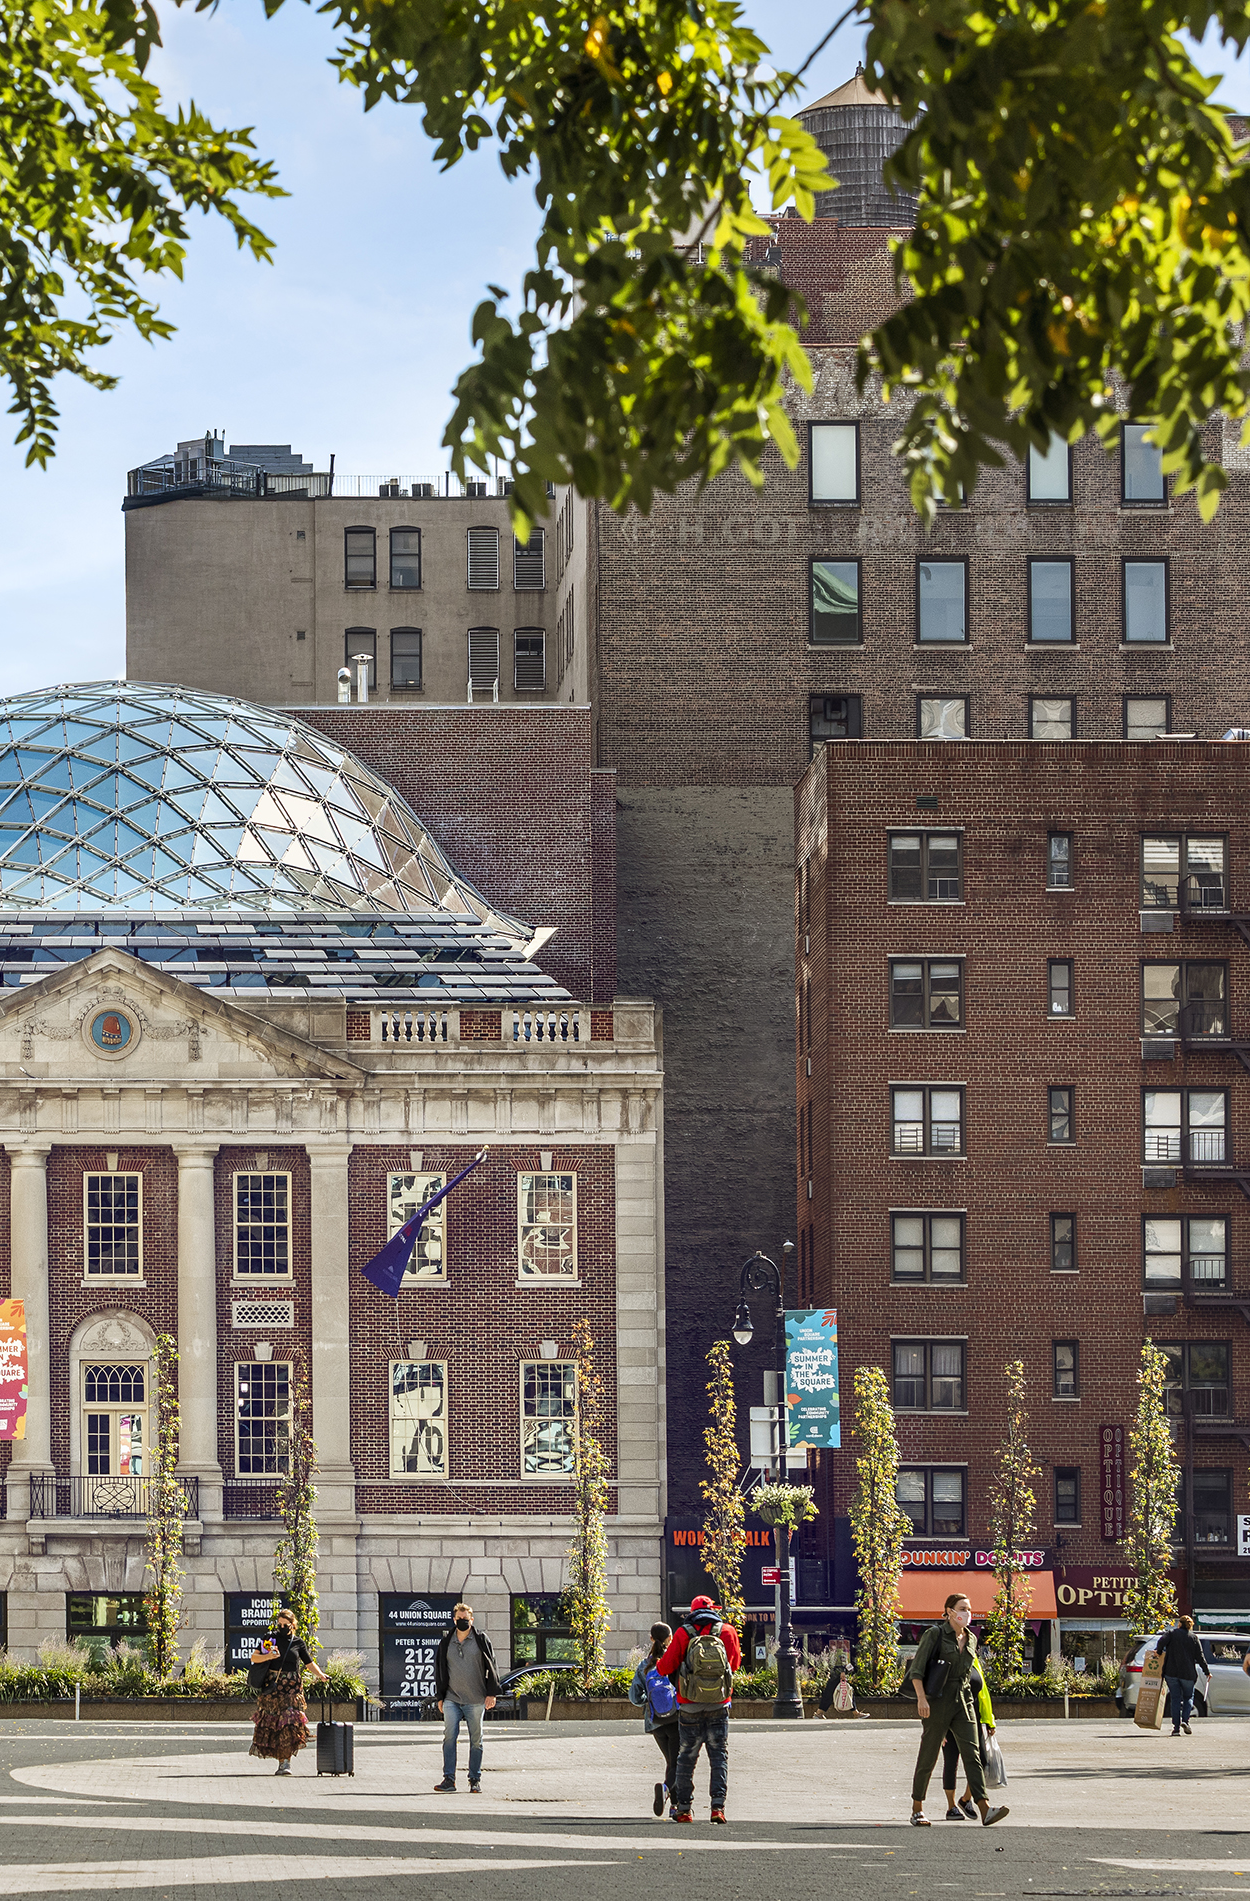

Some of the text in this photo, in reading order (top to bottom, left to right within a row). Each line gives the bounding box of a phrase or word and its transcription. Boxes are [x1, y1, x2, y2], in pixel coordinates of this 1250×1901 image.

[794, 1355, 829, 1363] SUMMER
[799, 1378, 831, 1387] SQUARE
[1103, 1428, 1114, 1537] OPTIQUE
[673, 1530, 706, 1546] WOK
[900, 1551, 971, 1566] DUNKIN'
[388, 1611, 452, 1619] 44 UNION SQUARE
[405, 1648, 435, 1664] 212
[405, 1665, 435, 1680] 372
